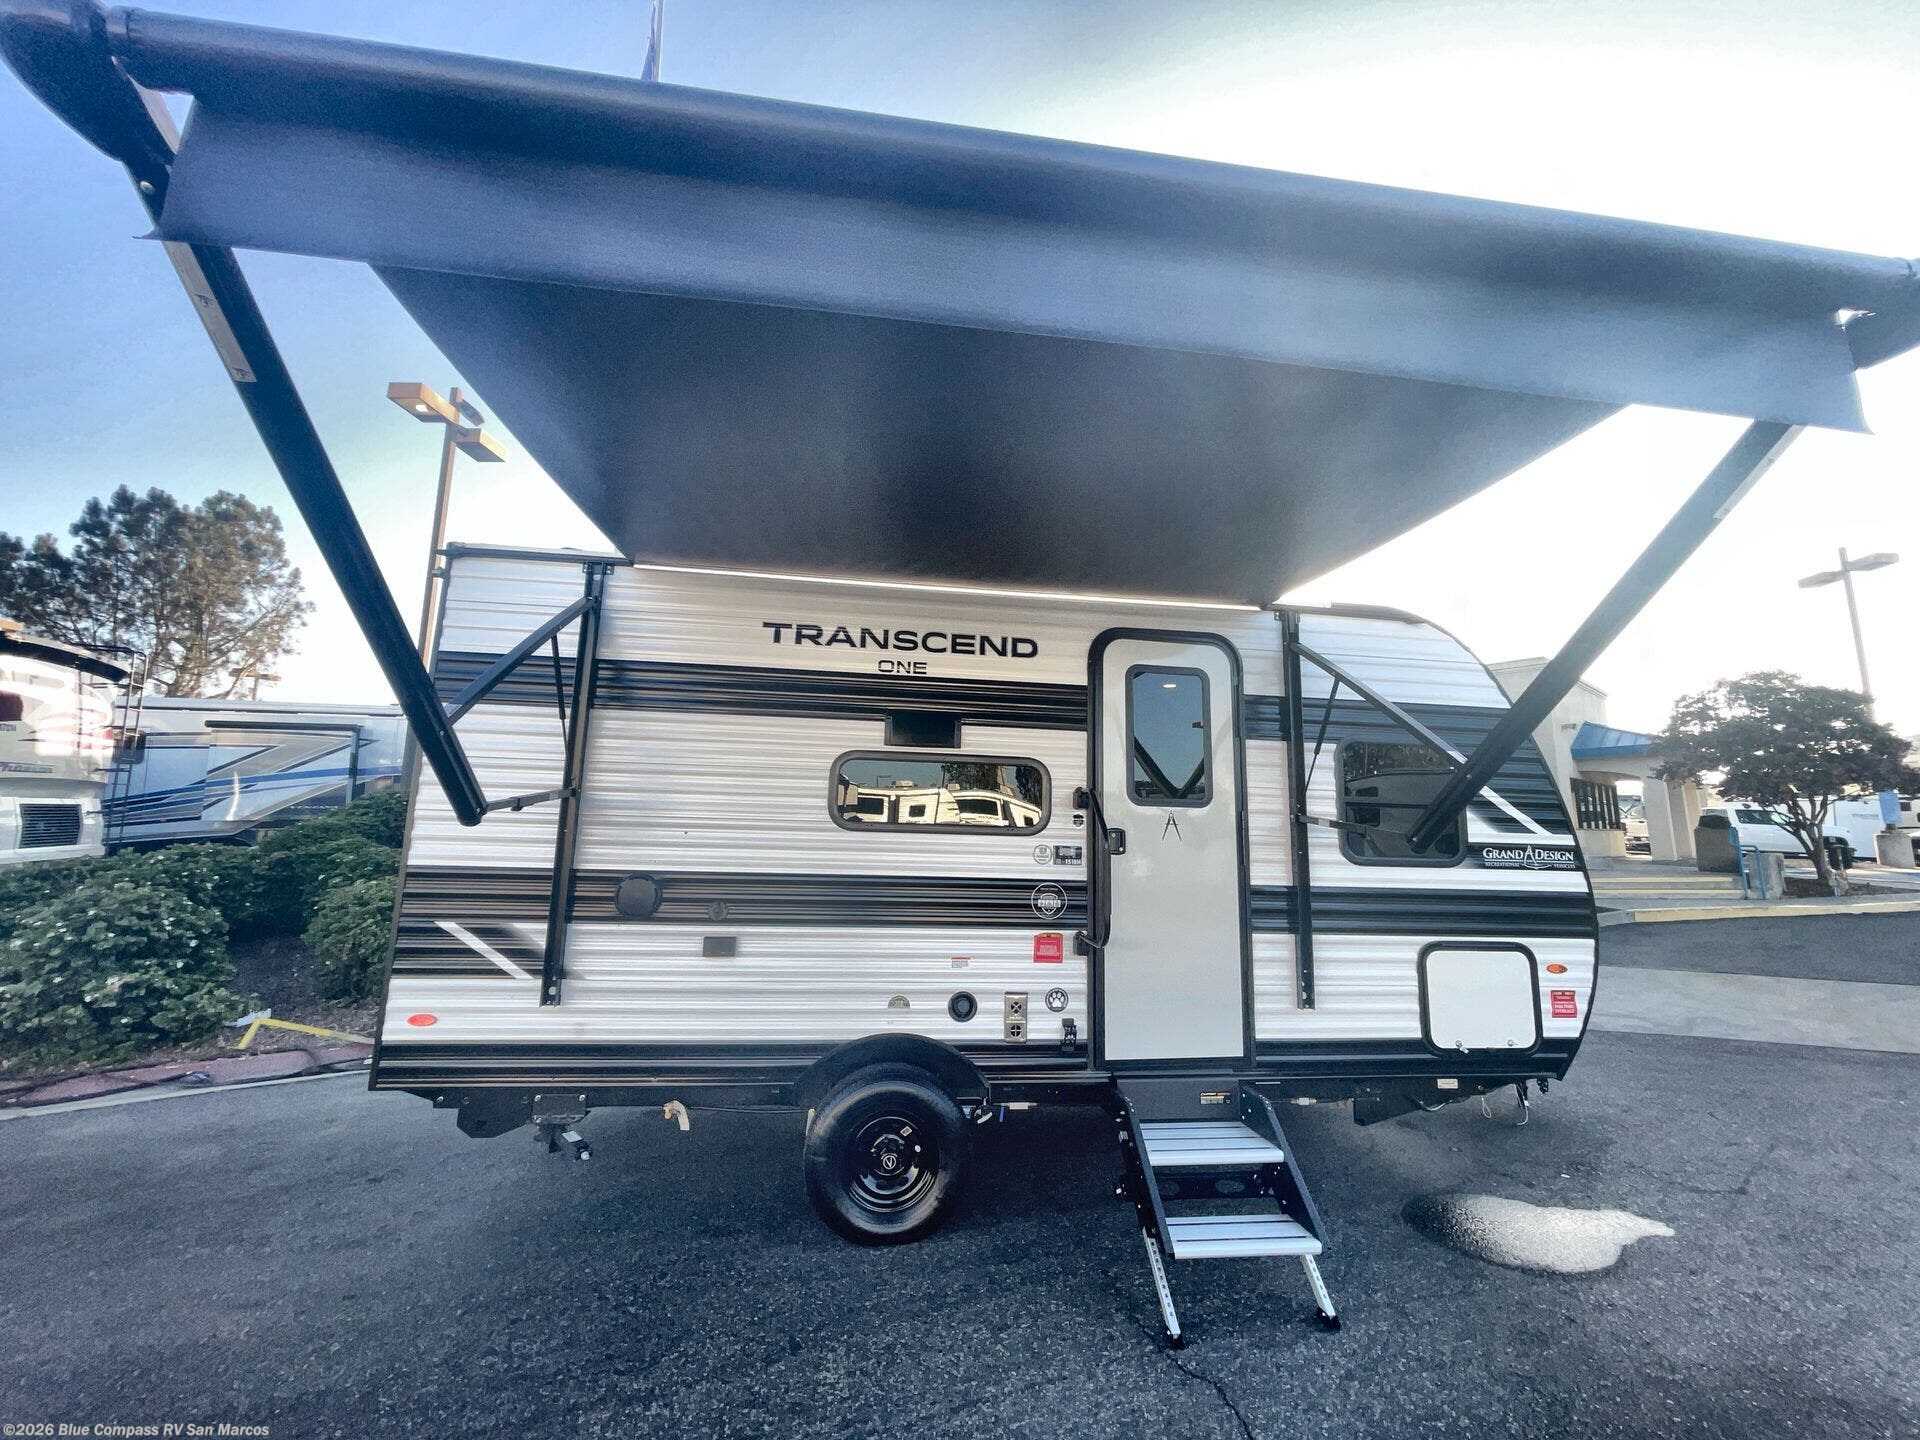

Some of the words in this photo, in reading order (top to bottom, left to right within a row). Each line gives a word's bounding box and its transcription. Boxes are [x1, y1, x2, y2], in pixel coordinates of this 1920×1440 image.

[762, 621, 1039, 658] TRANSCEND
[877, 659, 928, 675] ONE
[1482, 847, 1523, 859] GRAND
[1535, 849, 1574, 861] DESIGN
